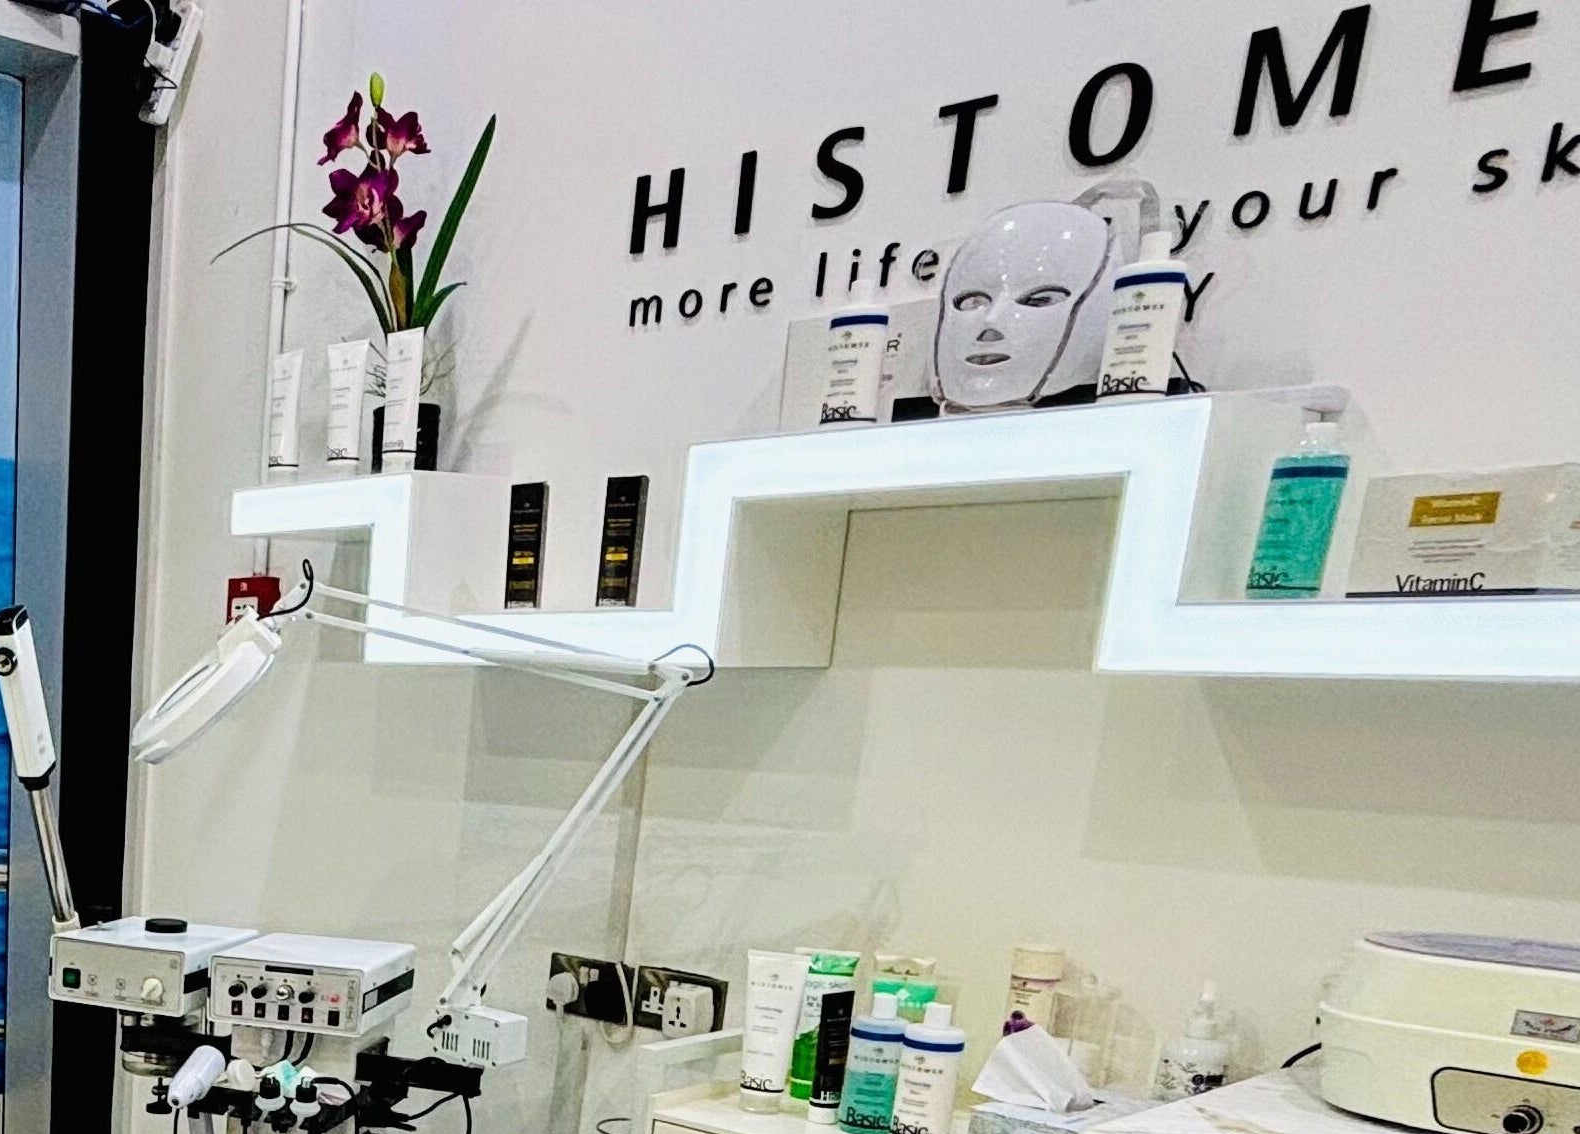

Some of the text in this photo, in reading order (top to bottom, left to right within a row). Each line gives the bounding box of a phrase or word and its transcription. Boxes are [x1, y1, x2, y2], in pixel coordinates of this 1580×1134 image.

[628, 277, 775, 328] more
[815, 242, 941, 297] life
[1170, 167, 1399, 254] your
[1101, 370, 1148, 393] Basic
[846, 1106, 888, 1129] Basic
